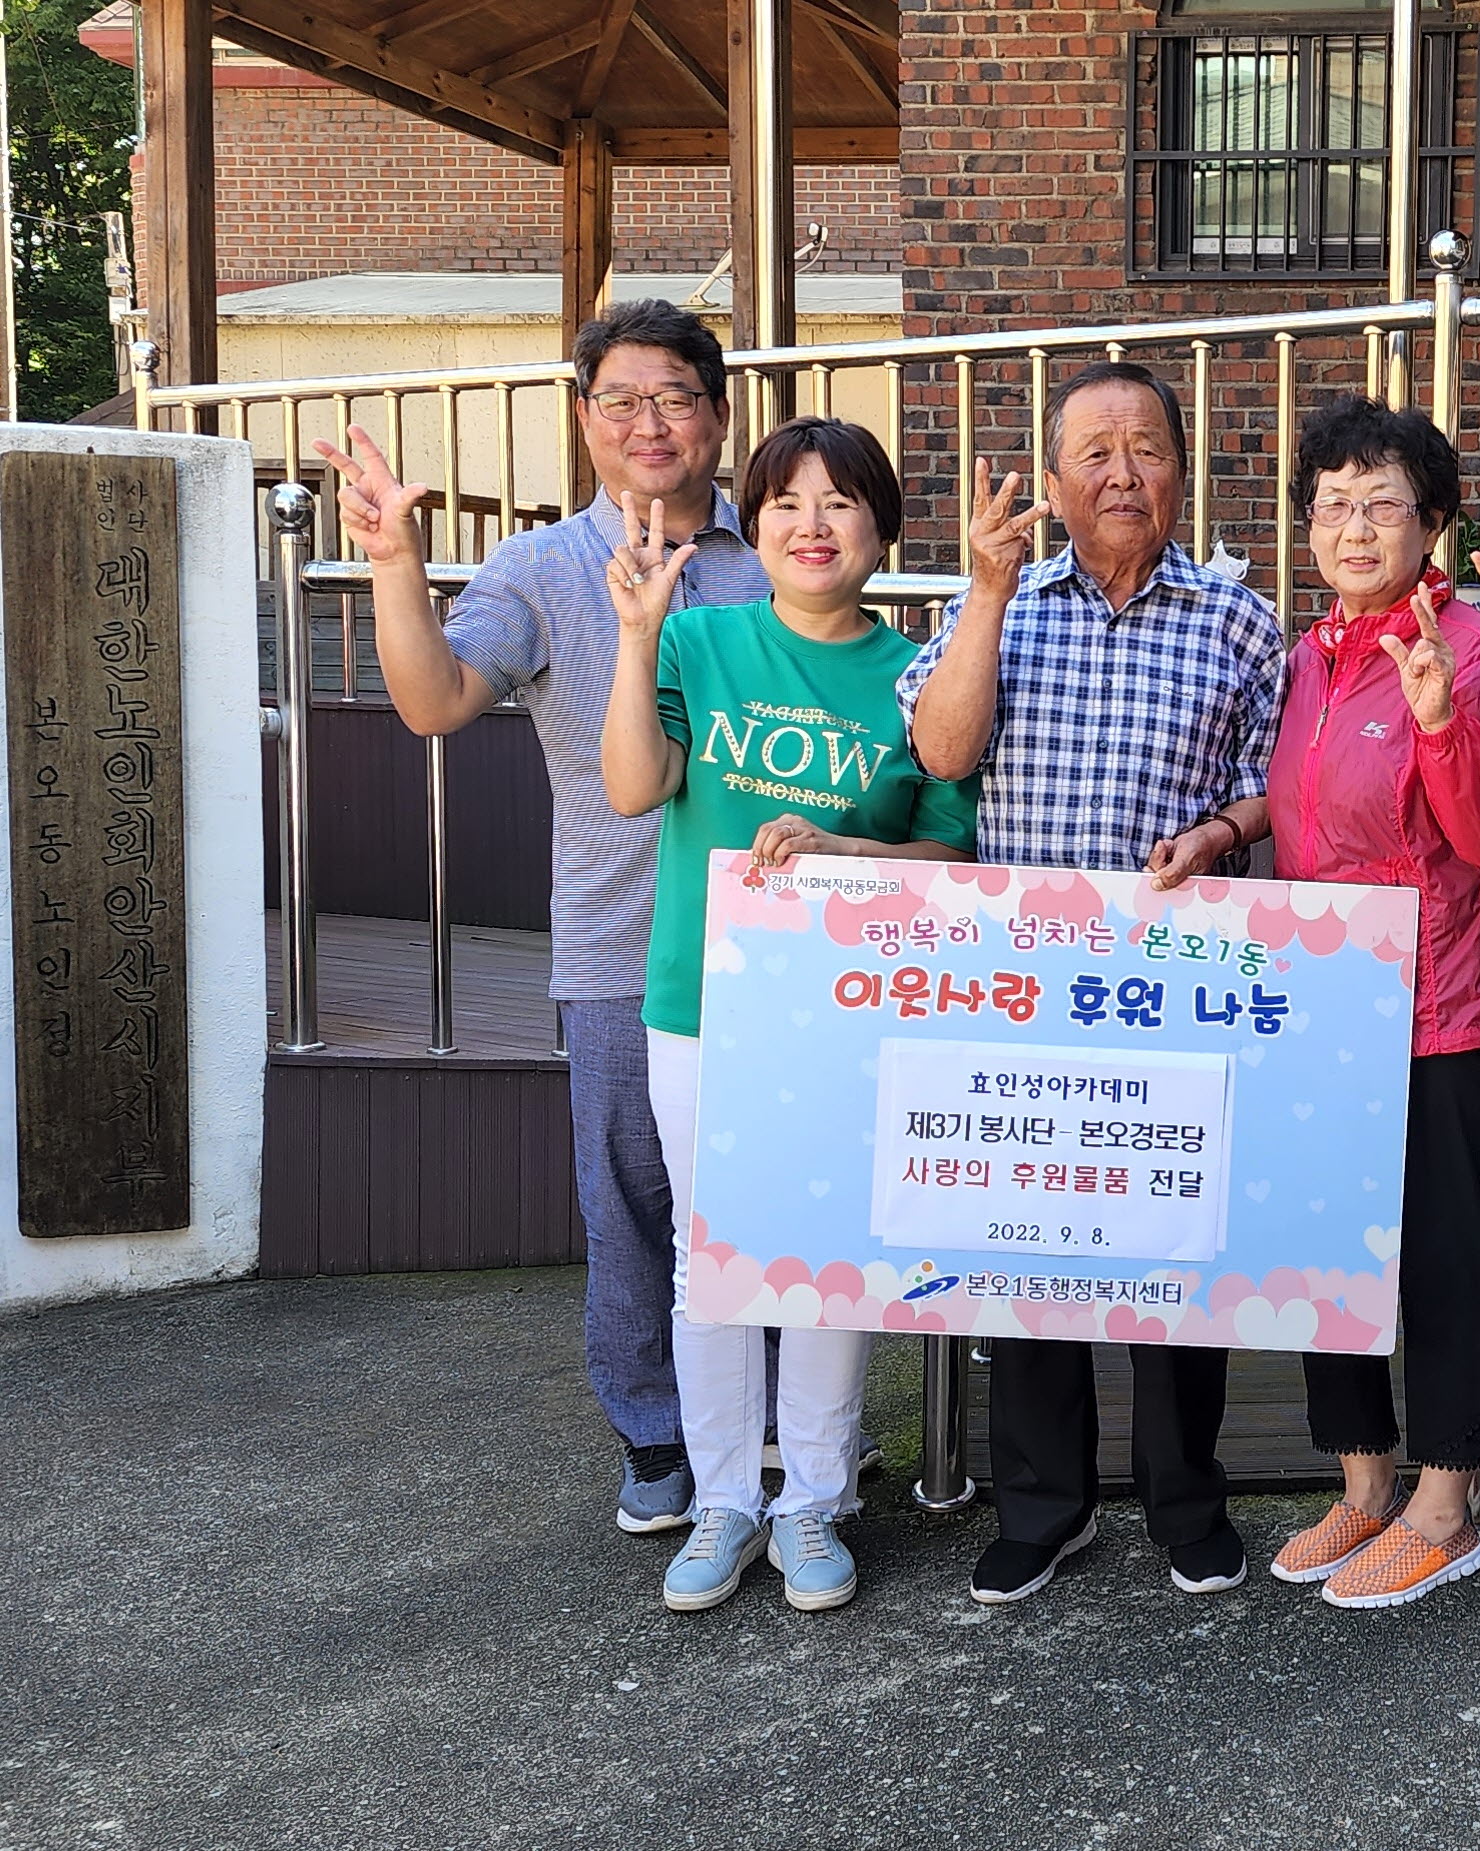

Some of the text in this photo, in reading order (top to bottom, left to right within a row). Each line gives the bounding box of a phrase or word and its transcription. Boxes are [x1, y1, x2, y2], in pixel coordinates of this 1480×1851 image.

[699, 711, 892, 792] NOW
[723, 773, 855, 812] TOMORROW
[770, 876, 900, 895] 경기 사회복지공동모금회
[864, 917, 1268, 977] 행복이 넘치는 본오1동
[834, 966, 1290, 1034] 이웃사랑 후원 나눔
[968, 1071, 1149, 1105] 효인성아카데미
[905, 1111, 971, 1142] 제3기
[1079, 1120, 1206, 1153] 본오경로당
[902, 1157, 1204, 1198] 사랑의 후원물품 전달
[988, 1222, 1111, 1247] 2022. 9. 8.
[966, 1273, 1183, 1305] 본오1동행정복지센터
